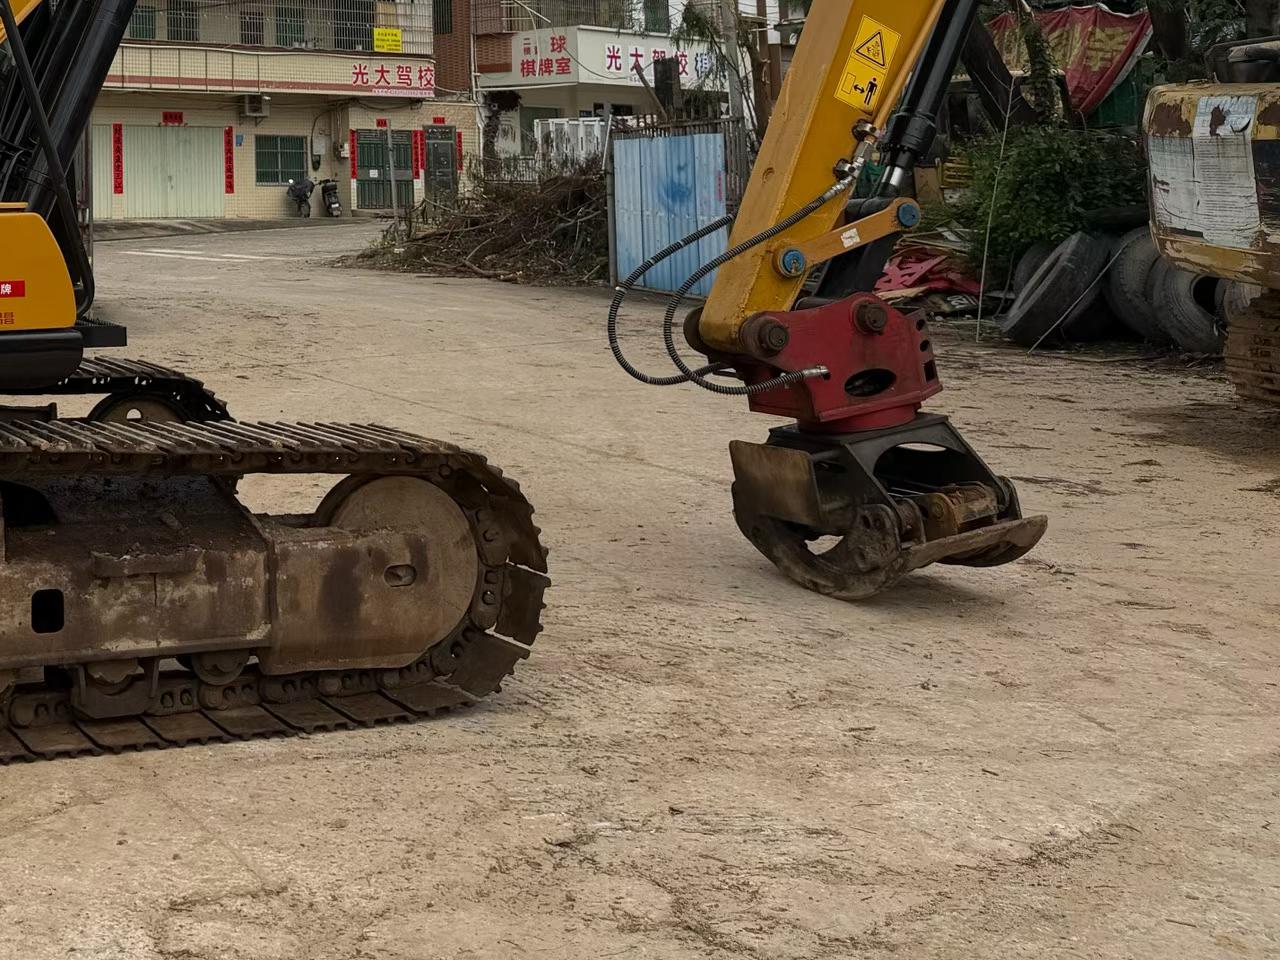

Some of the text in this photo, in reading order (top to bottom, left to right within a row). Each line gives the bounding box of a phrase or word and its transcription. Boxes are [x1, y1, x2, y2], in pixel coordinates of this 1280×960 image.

[352, 63, 435, 88] 光大驾校
[520, 56, 571, 78] 棋牌室
